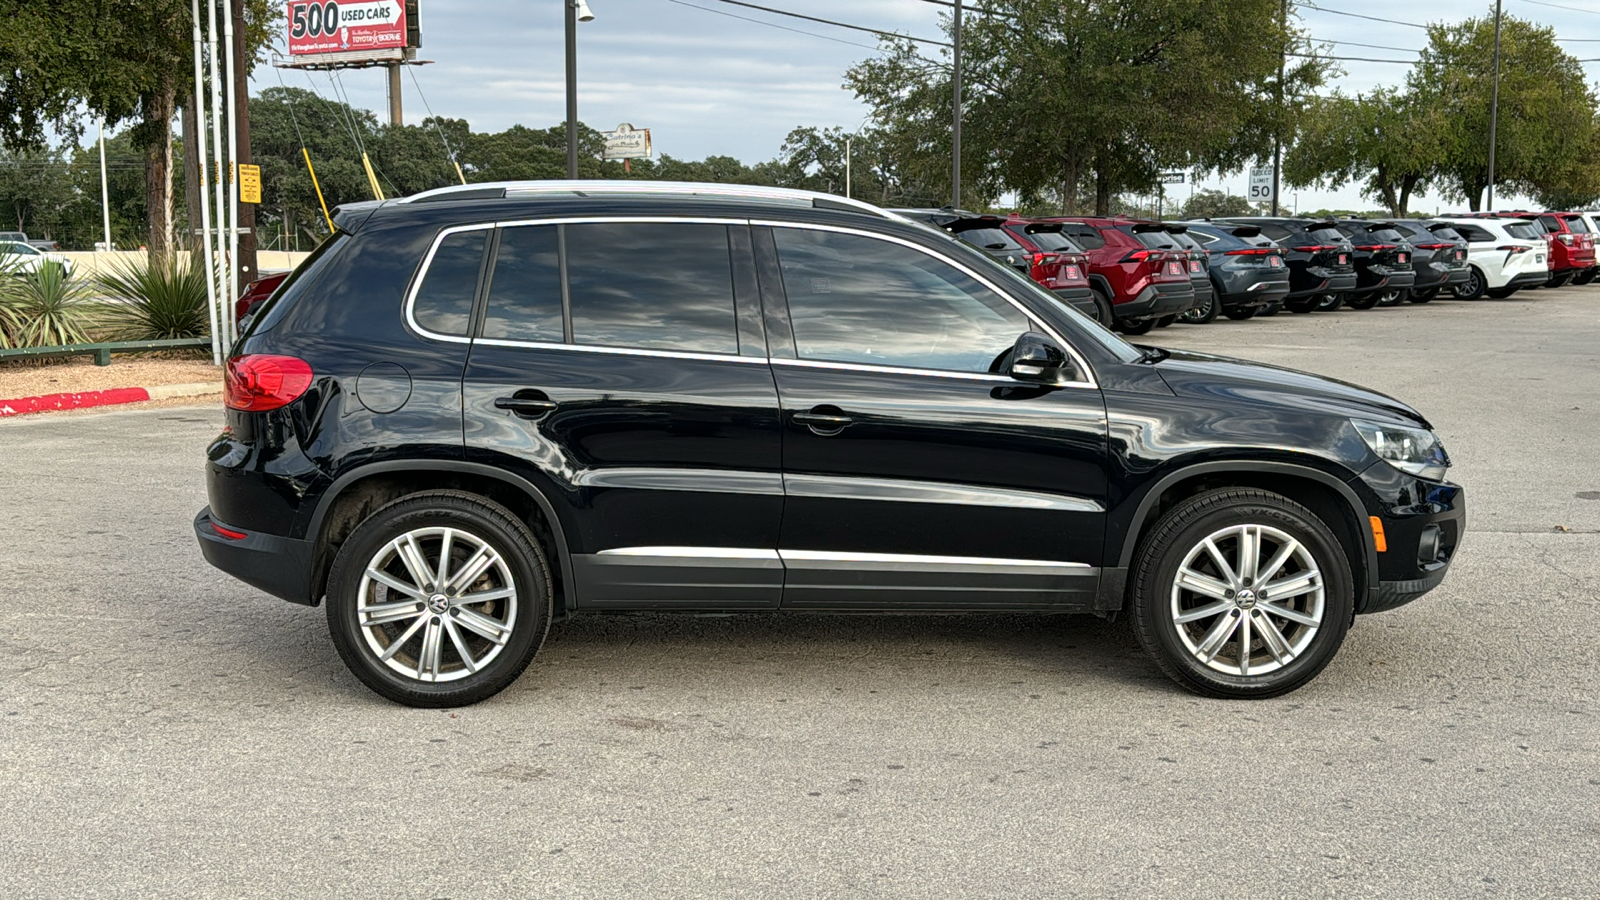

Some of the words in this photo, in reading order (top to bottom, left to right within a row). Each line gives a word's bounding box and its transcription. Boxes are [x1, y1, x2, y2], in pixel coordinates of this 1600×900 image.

[290, 1, 338, 38] 500
[341, 9, 365, 21] USED
[366, 7, 390, 19] CARS
[1251, 185, 1270, 197] 50
